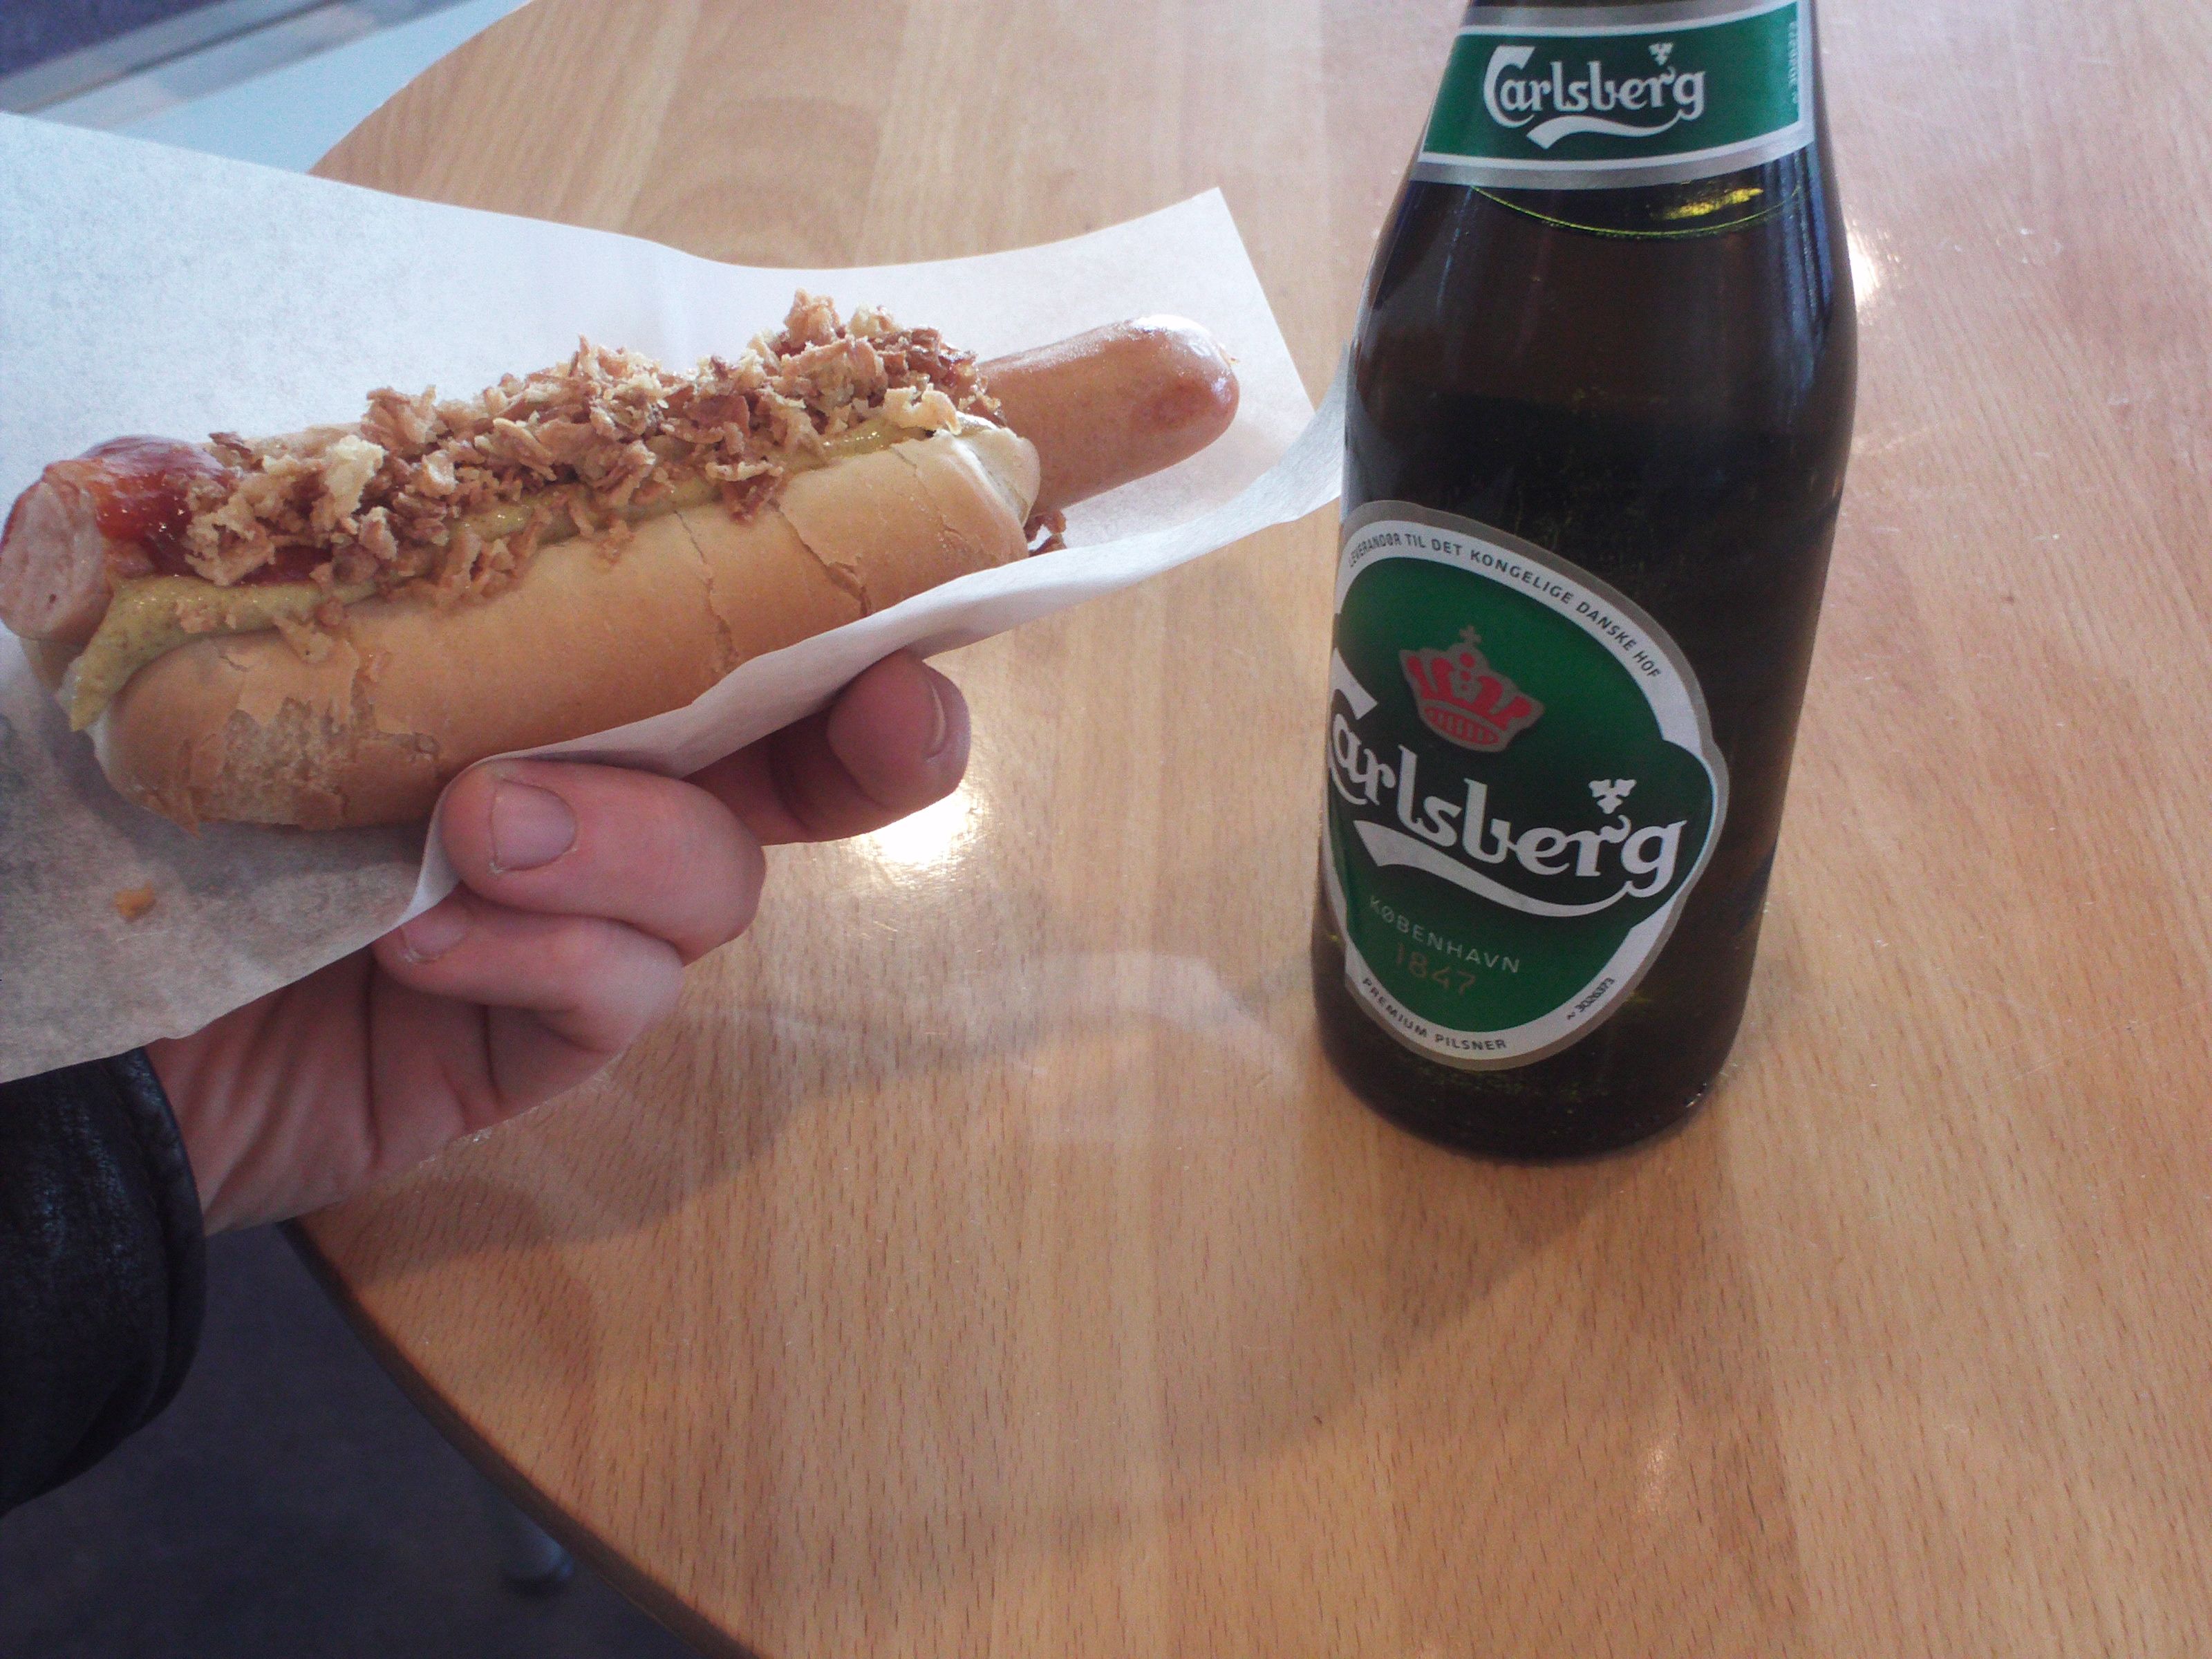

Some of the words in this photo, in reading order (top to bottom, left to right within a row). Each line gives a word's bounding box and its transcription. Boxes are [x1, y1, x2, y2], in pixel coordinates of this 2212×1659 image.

[1483, 44, 1706, 149] Carlsberg
[1405, 533, 1427, 549] TIL
[1432, 538, 1461, 556] DET
[1470, 549, 1573, 605] KONGELIGE
[1575, 601, 1637, 652] DANSKE
[1633, 649, 1662, 679] HOF
[1326, 647, 1687, 917] Carlsberg
[1369, 896, 1520, 973] KØBENHAVN
[1394, 943, 1477, 995] 1847
[1362, 977, 1428, 1039] PREMIUM
[1435, 1032, 1507, 1051] PILSNER
